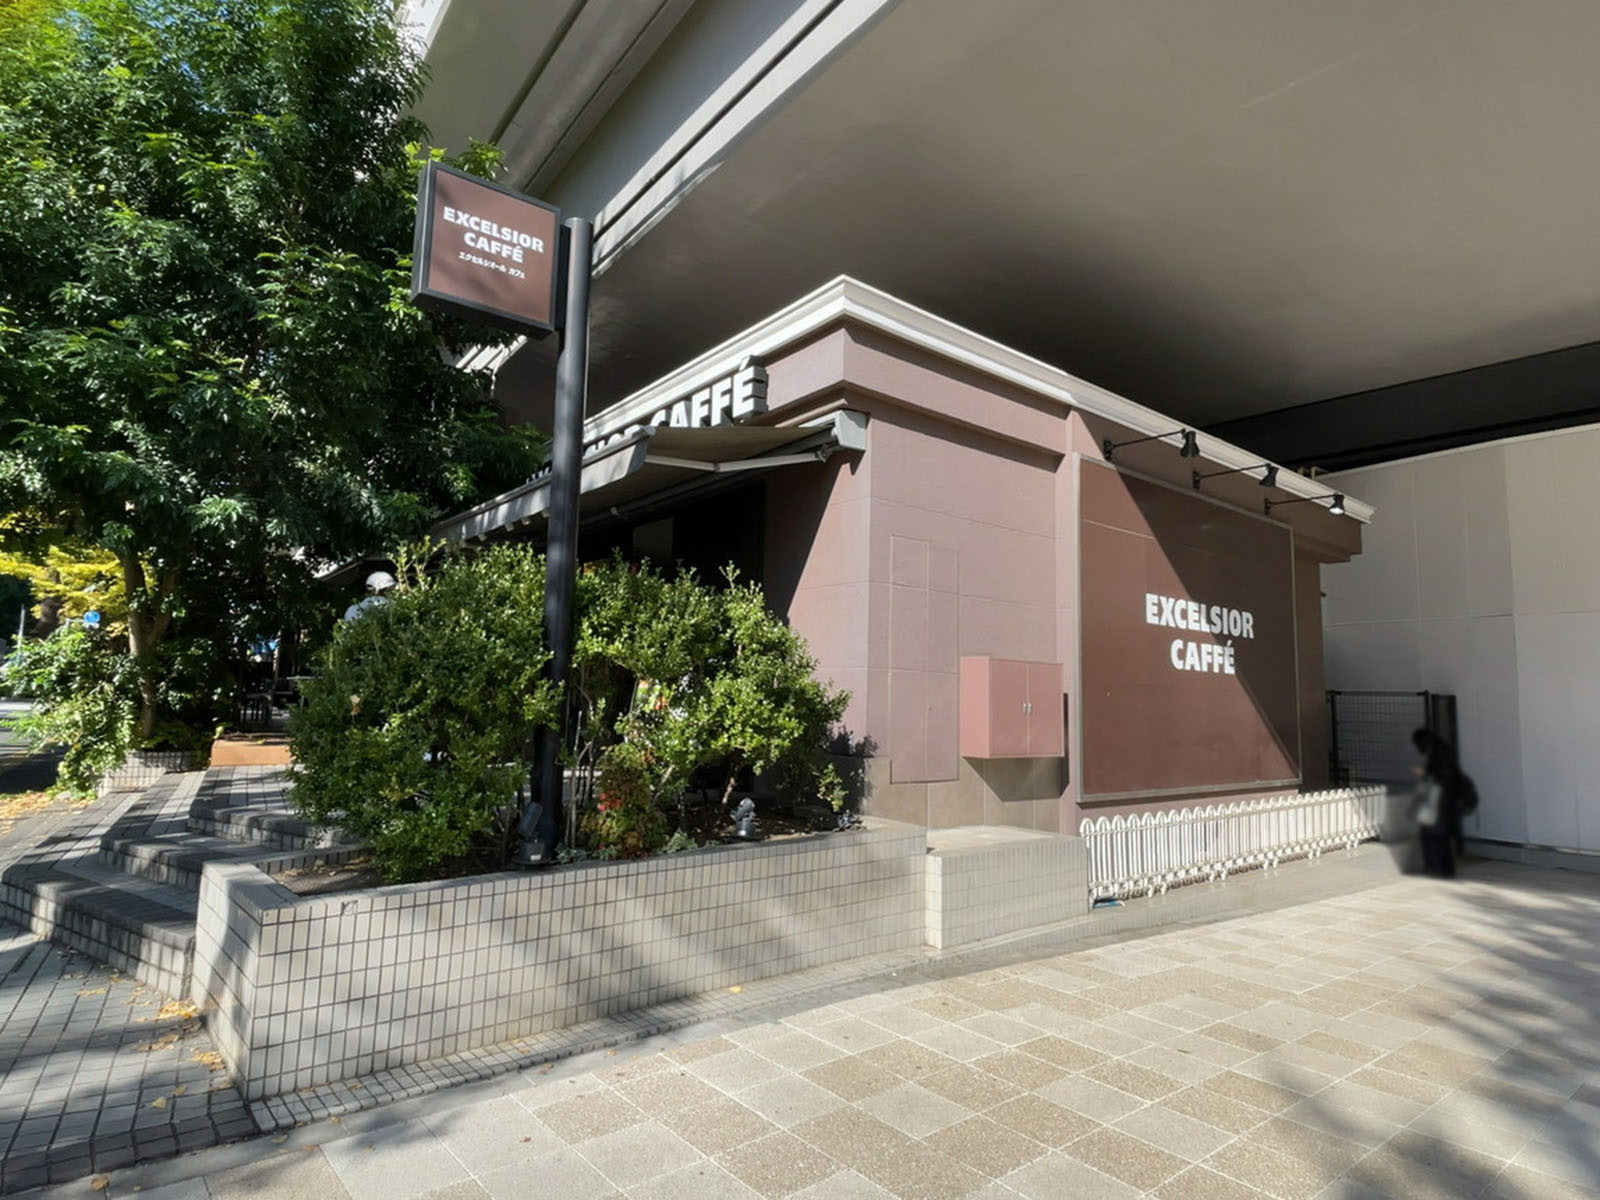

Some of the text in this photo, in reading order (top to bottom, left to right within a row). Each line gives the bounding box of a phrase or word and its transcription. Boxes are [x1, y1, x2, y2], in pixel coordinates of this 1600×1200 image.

[443, 206, 544, 253] EXCELSIOR
[464, 232, 524, 263] CAFFÉ
[458, 251, 526, 279] エクセルシオール カフェ
[1145, 593, 1255, 639] EXCELSIOR
[1170, 639, 1236, 675] CAFFÉ
